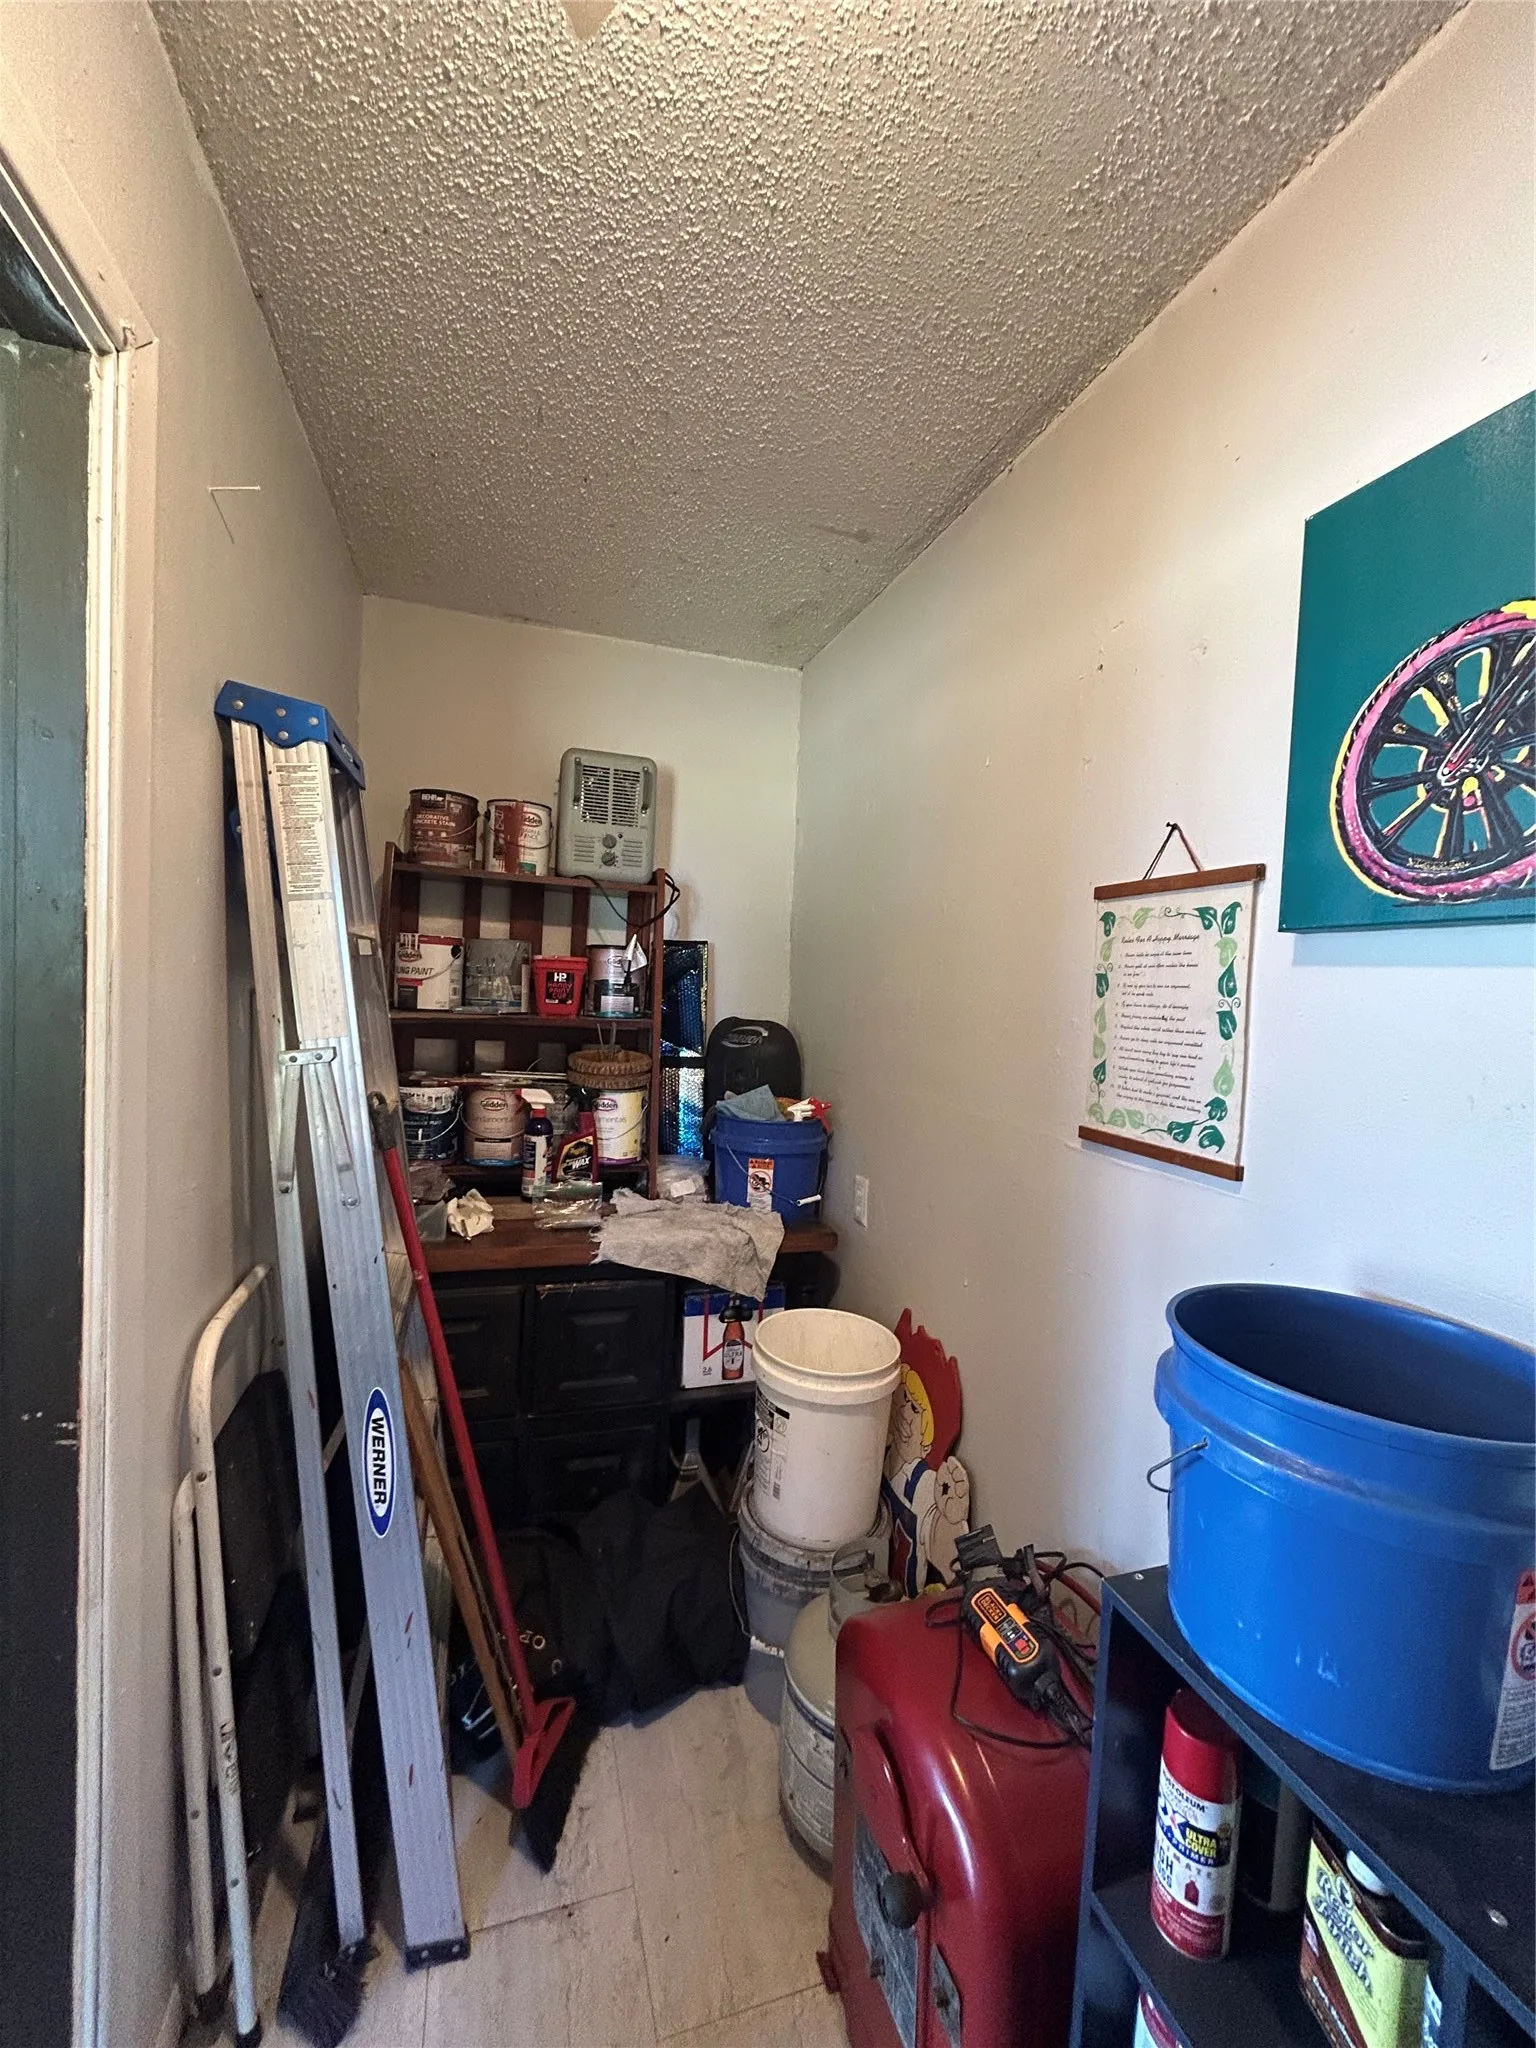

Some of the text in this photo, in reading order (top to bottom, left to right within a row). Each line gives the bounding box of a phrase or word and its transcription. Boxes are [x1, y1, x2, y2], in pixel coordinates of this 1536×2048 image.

[438, 820, 456, 828] STAIN
[411, 967, 434, 975] PAINT
[480, 1100, 508, 1109] Glidden
[572, 1155, 592, 1170] WAX
[371, 1416, 387, 1505] WERNER
[1185, 1827, 1217, 1849] ULTRA
[1185, 1838, 1217, 1859] COVER
